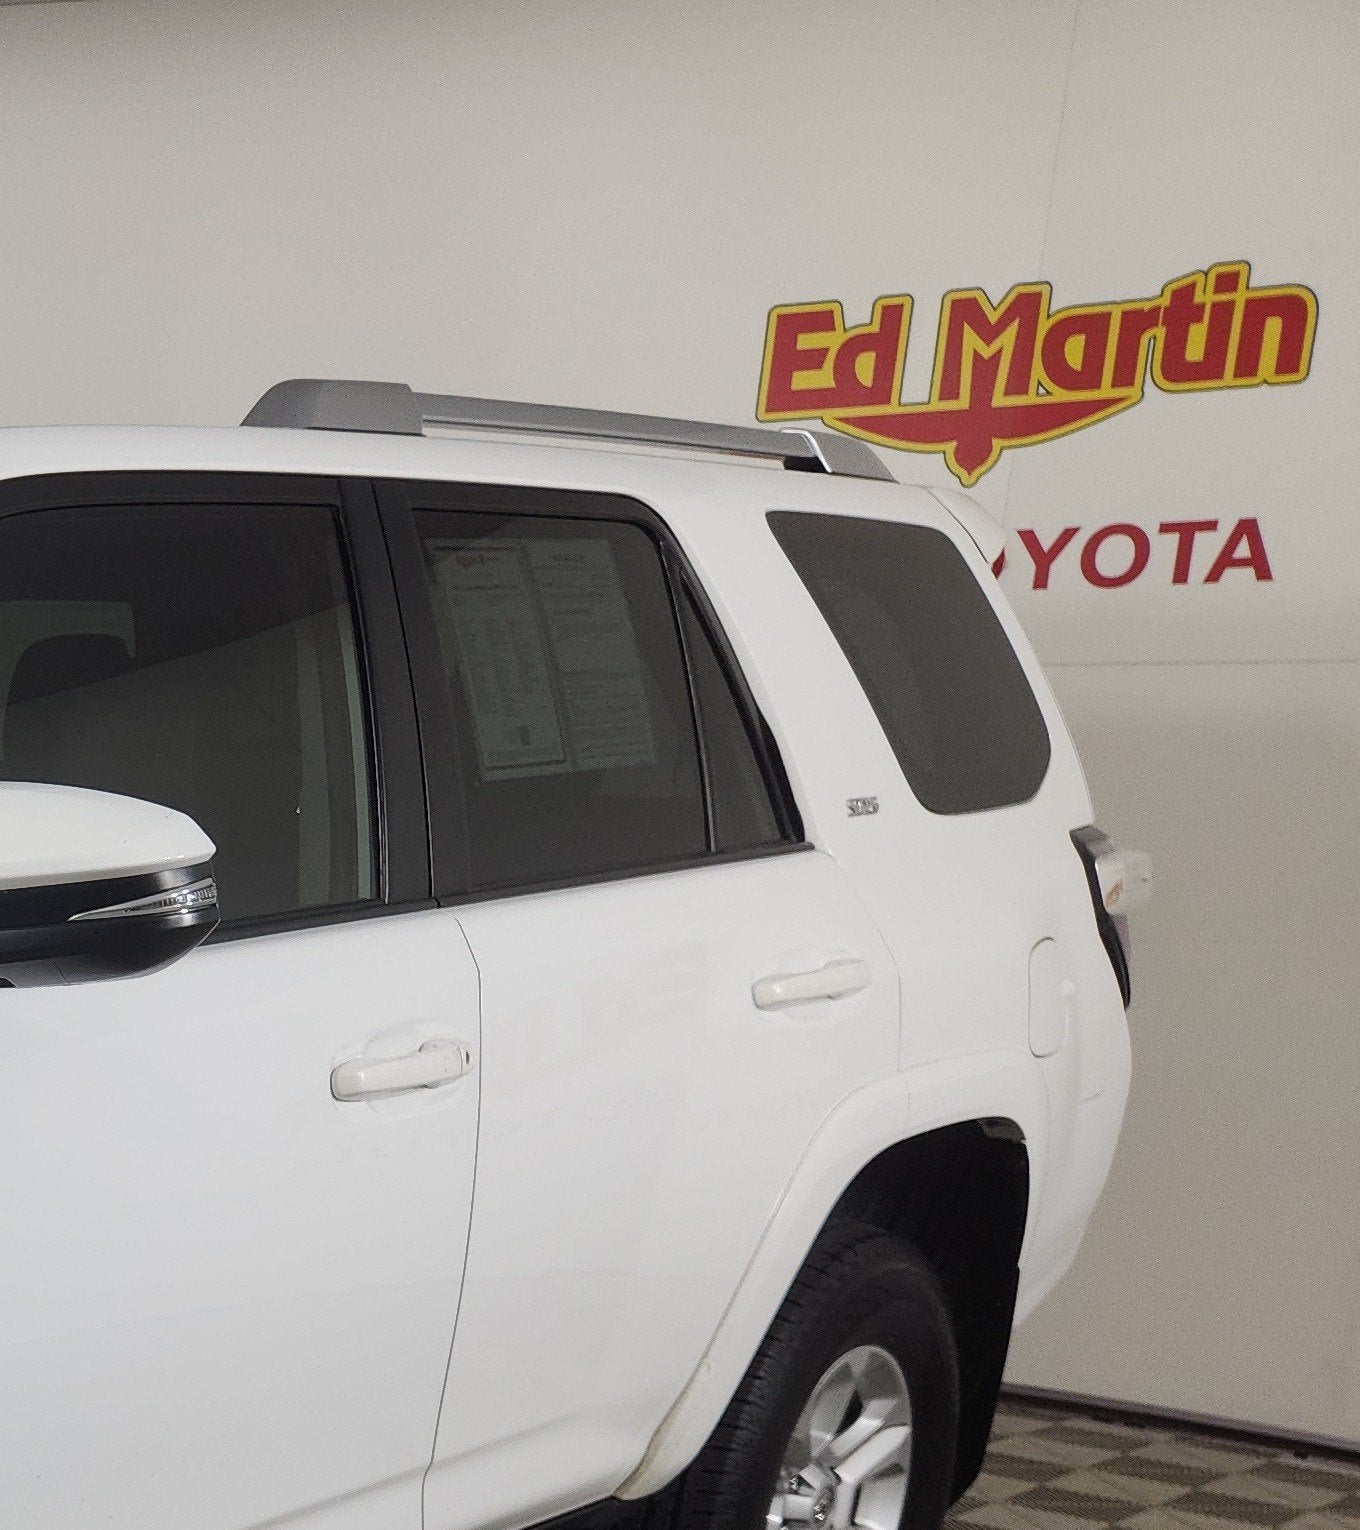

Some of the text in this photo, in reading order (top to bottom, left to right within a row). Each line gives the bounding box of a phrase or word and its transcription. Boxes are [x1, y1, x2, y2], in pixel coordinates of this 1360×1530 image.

[765, 268, 1309, 414] Ed Martin
[991, 517, 1275, 592] YOTA
